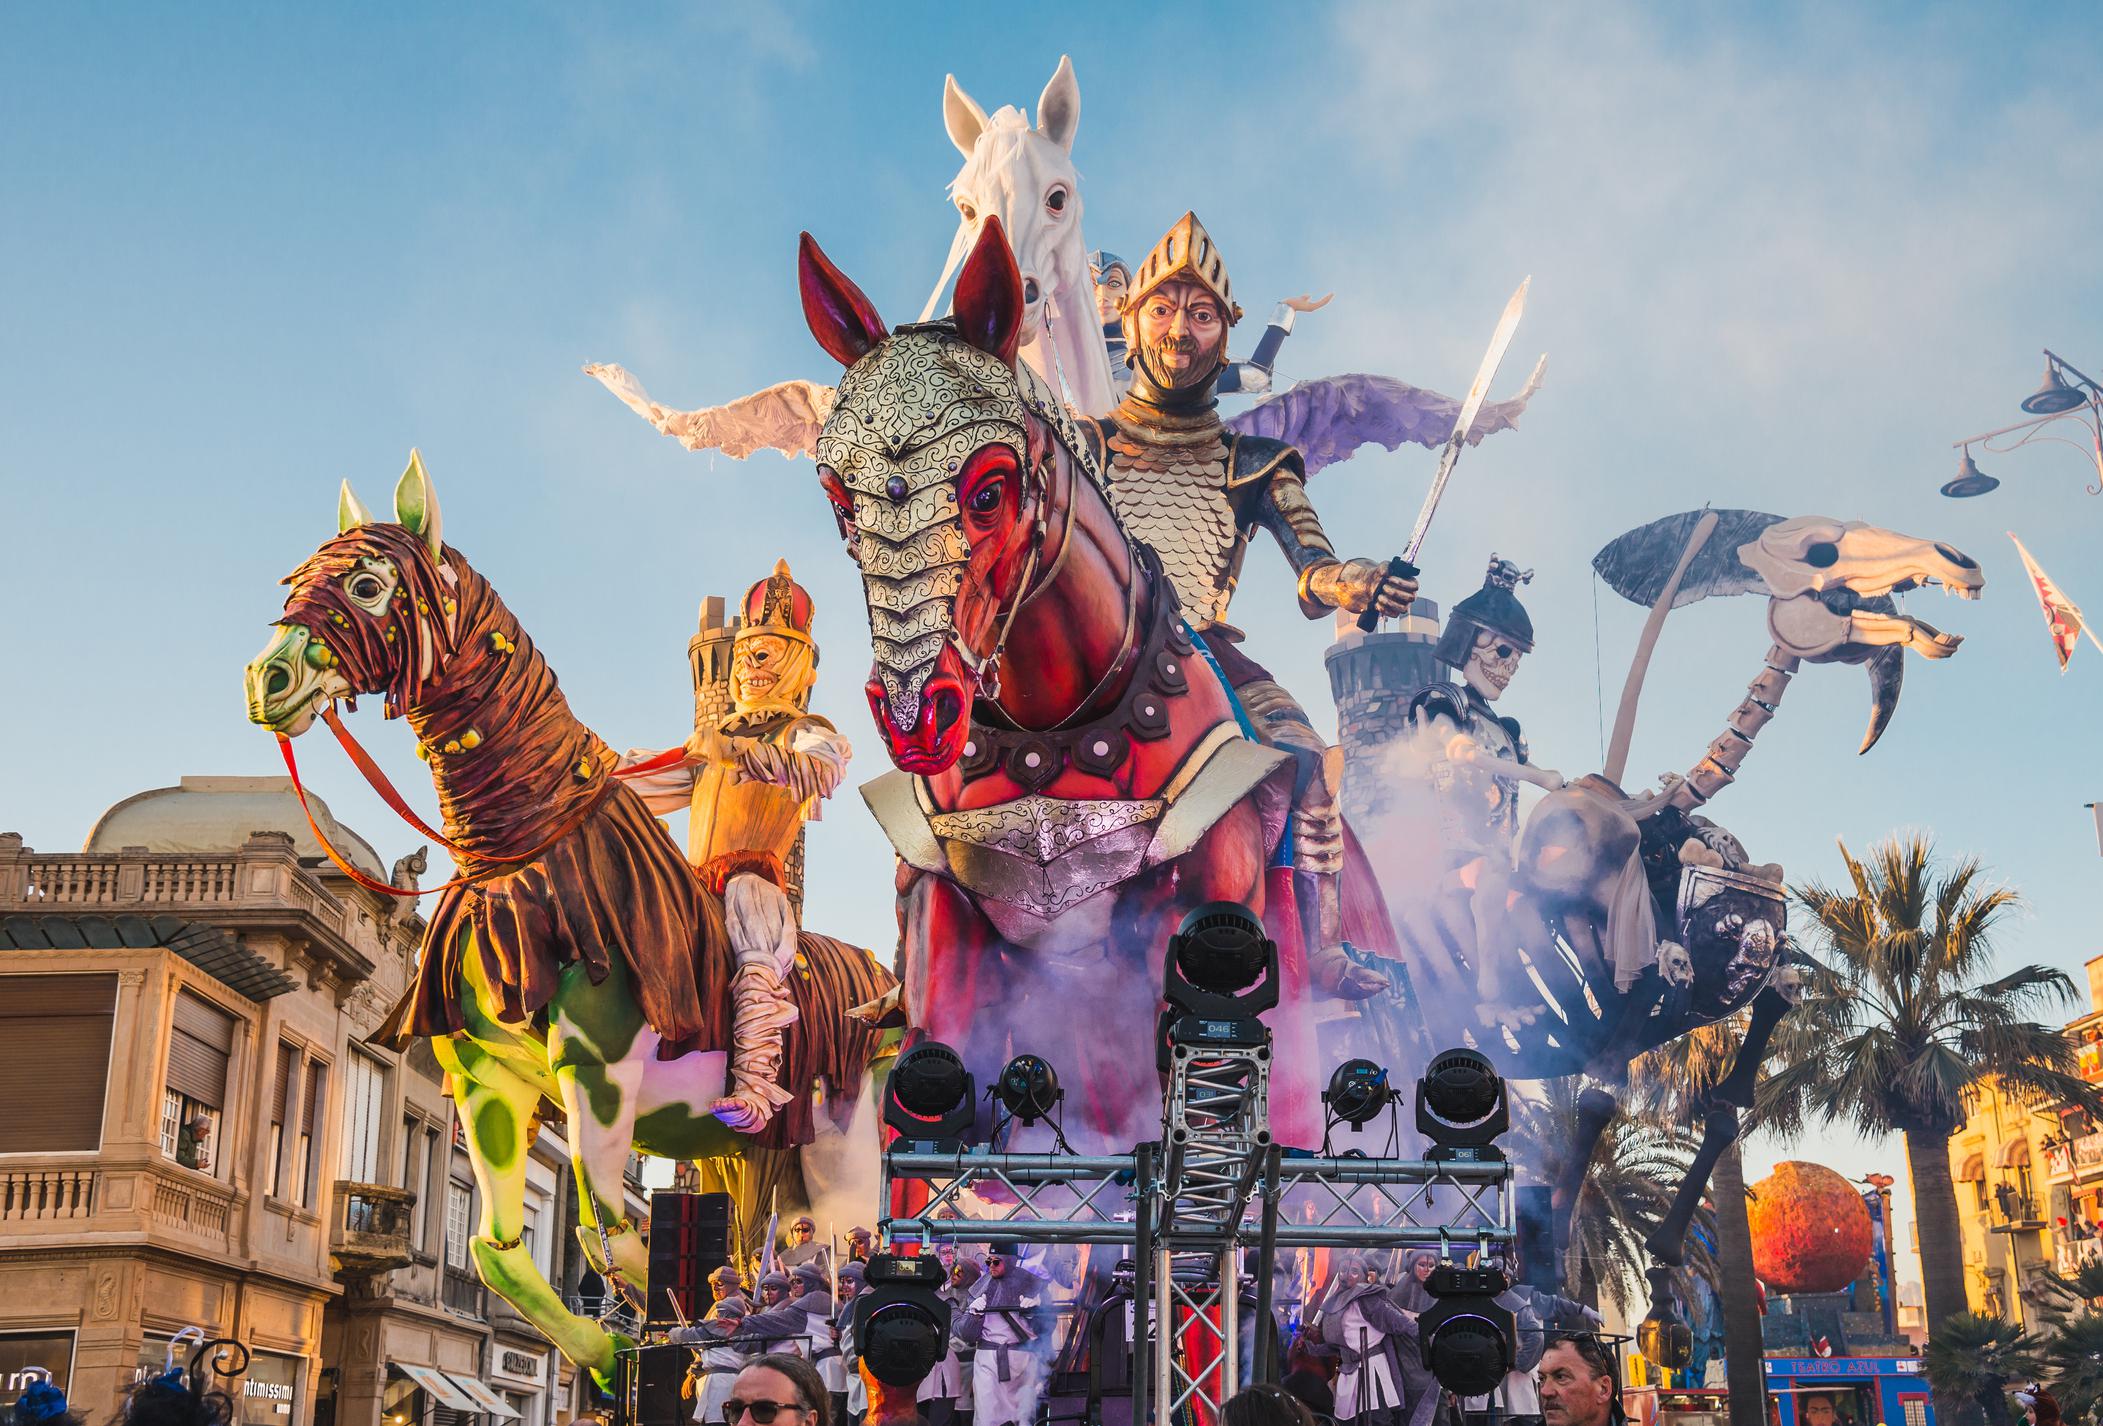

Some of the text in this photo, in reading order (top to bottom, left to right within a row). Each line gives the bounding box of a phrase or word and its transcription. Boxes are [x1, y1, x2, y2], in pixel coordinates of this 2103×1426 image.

[1208, 1024, 1231, 1033] 046
[1791, 1361, 1880, 1374] TEATRO AZUL
[243, 1378, 293, 1401] ntimissimi
